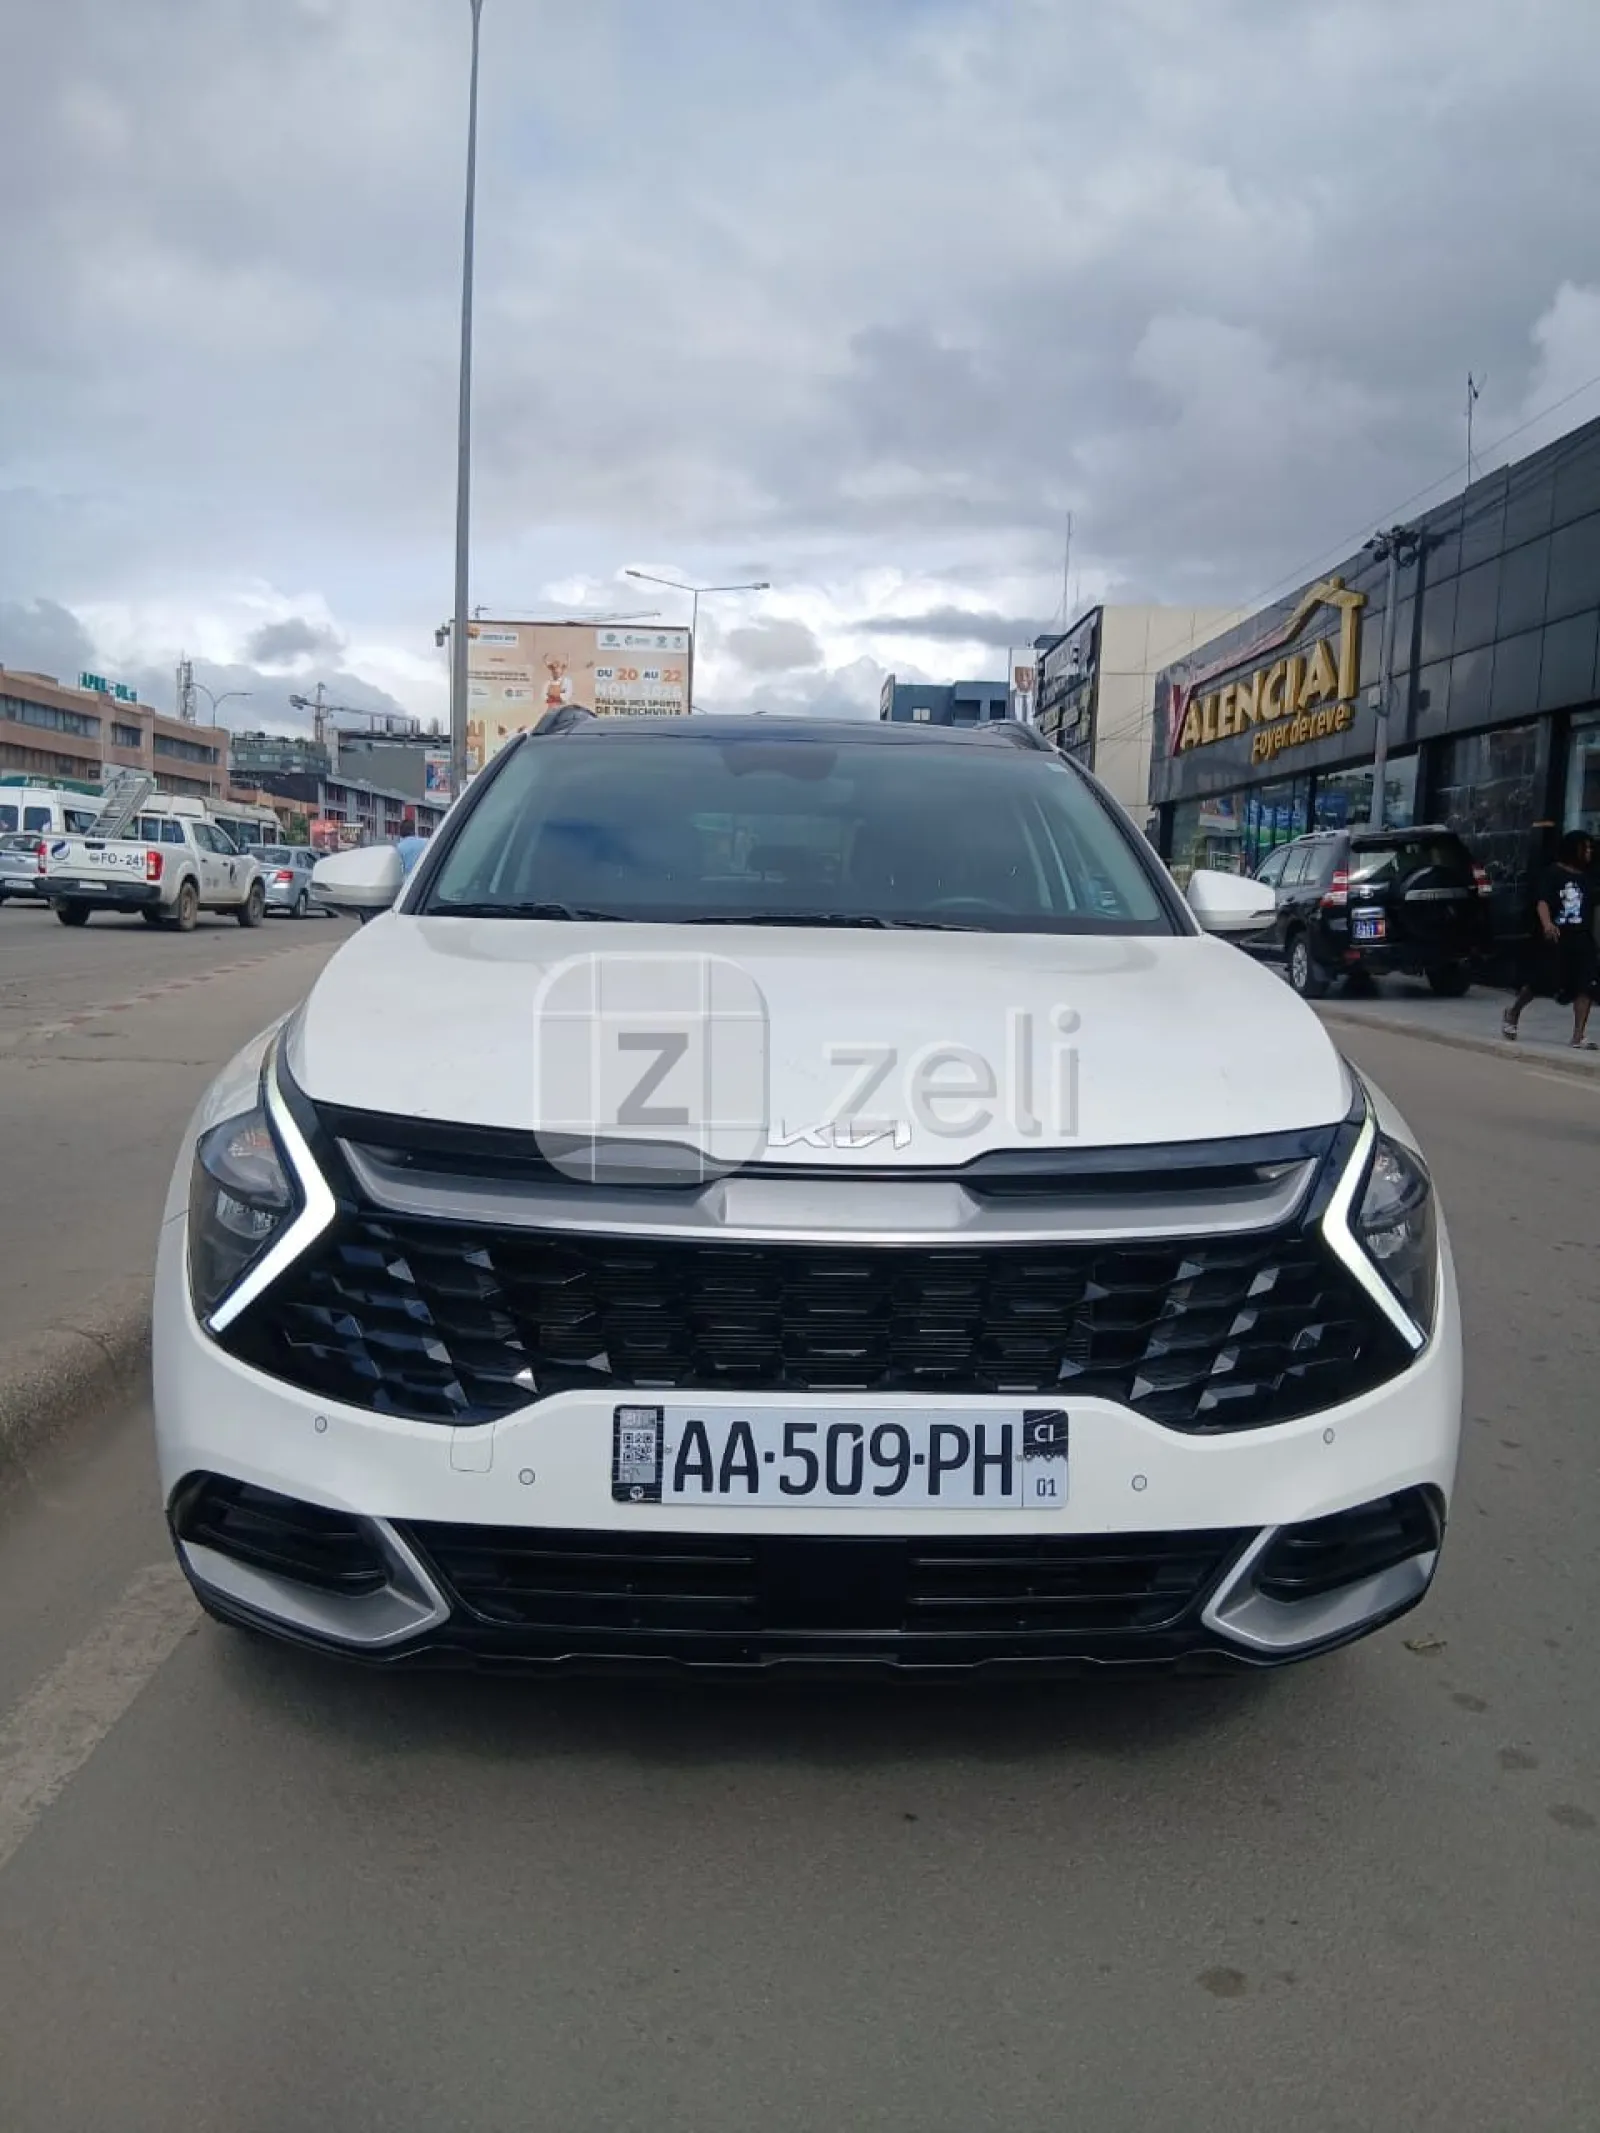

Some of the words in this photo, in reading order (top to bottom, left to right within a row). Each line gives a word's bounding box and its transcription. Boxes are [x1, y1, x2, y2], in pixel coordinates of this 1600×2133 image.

[597, 669, 612, 677] DU
[618, 668, 638, 680] 20
[643, 671, 659, 679] AU
[663, 670, 682, 682] 22
[1169, 638, 1340, 757] VALENCIA
[595, 706, 611, 715] DE
[1034, 1424, 1054, 1442] CI
[1037, 1478, 1058, 1497] 01
